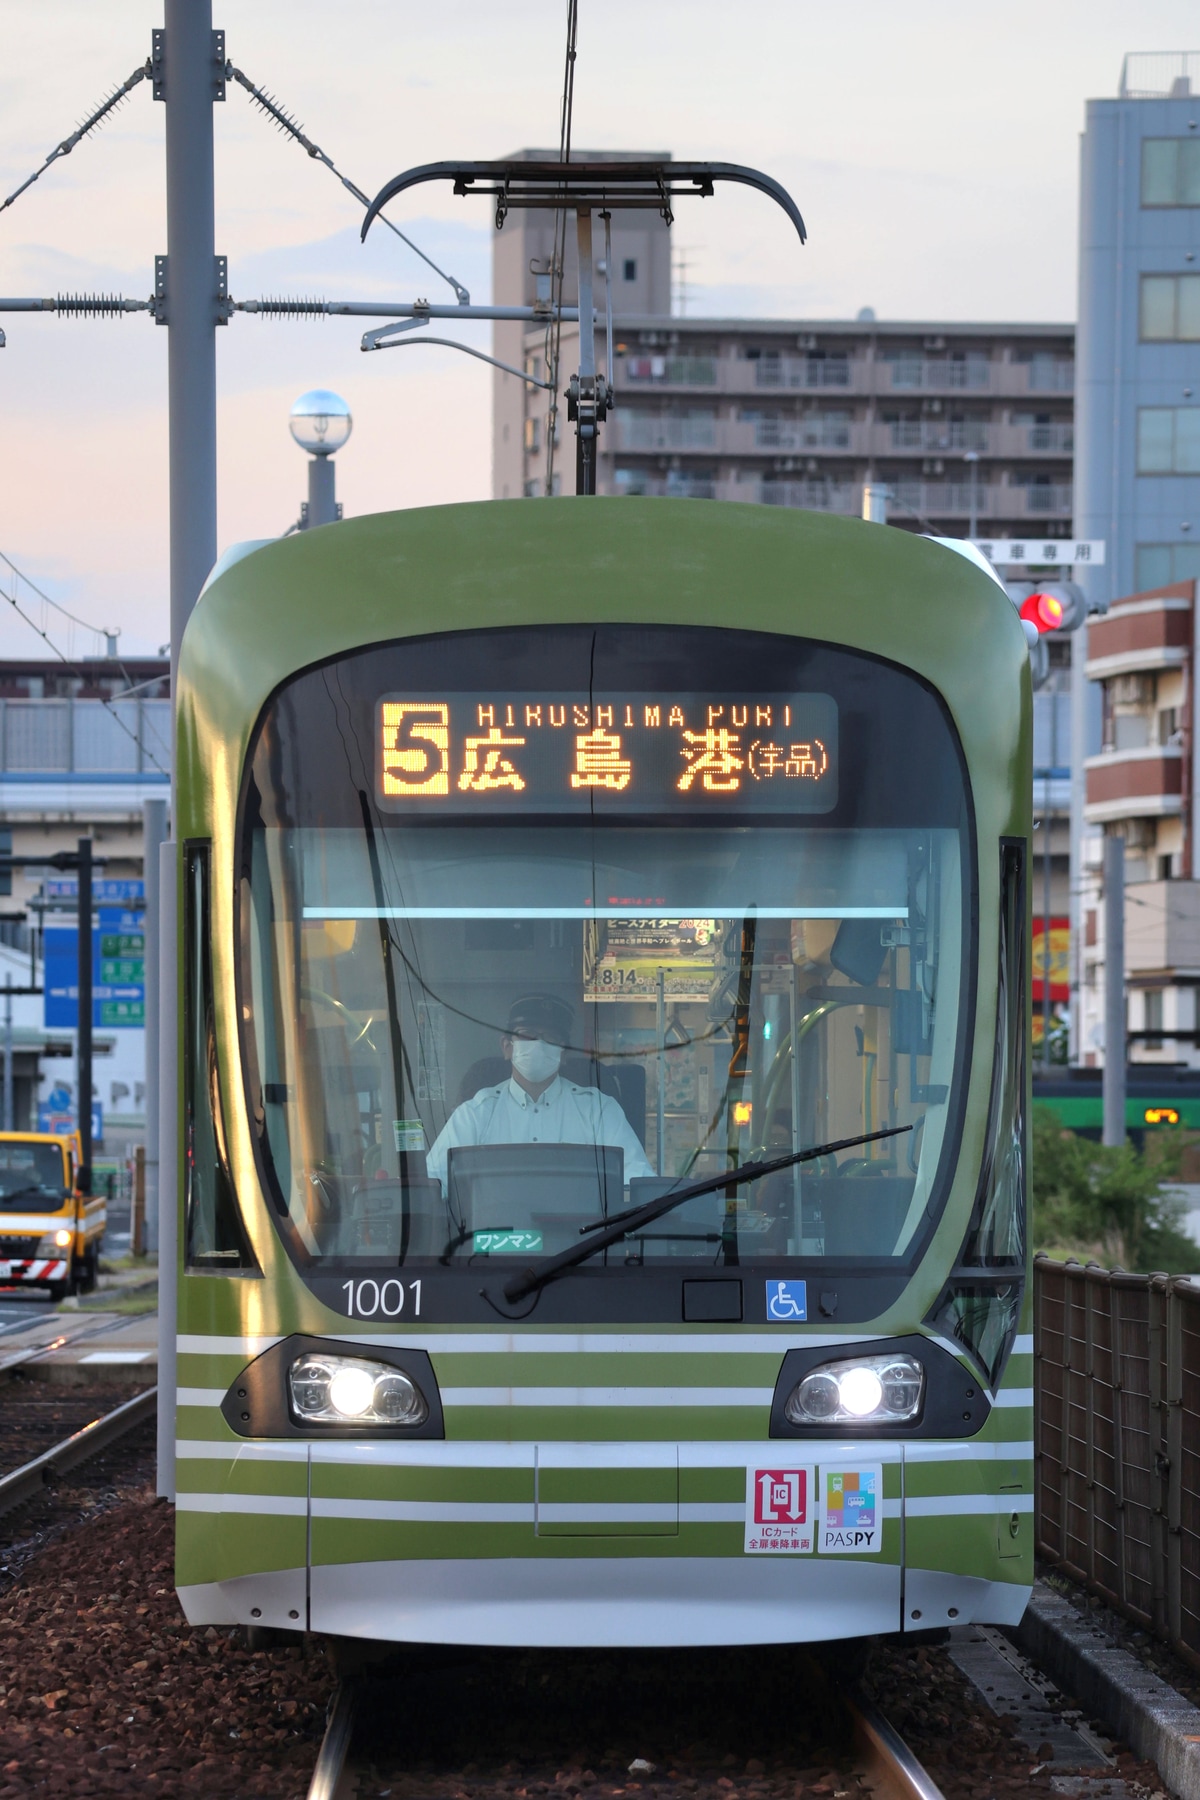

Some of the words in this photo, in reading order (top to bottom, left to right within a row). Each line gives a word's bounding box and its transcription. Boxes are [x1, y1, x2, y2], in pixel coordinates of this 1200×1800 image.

[385, 710, 442, 785] 5
[476, 1234, 542, 1250] ワンマン
[342, 1279, 422, 1316] 1001
[776, 1489, 786, 1500] IC
[761, 1527, 798, 1537] ICカード
[825, 1532, 875, 1547] PASPY
[749, 1538, 810, 1550] 全扉乗降車両
